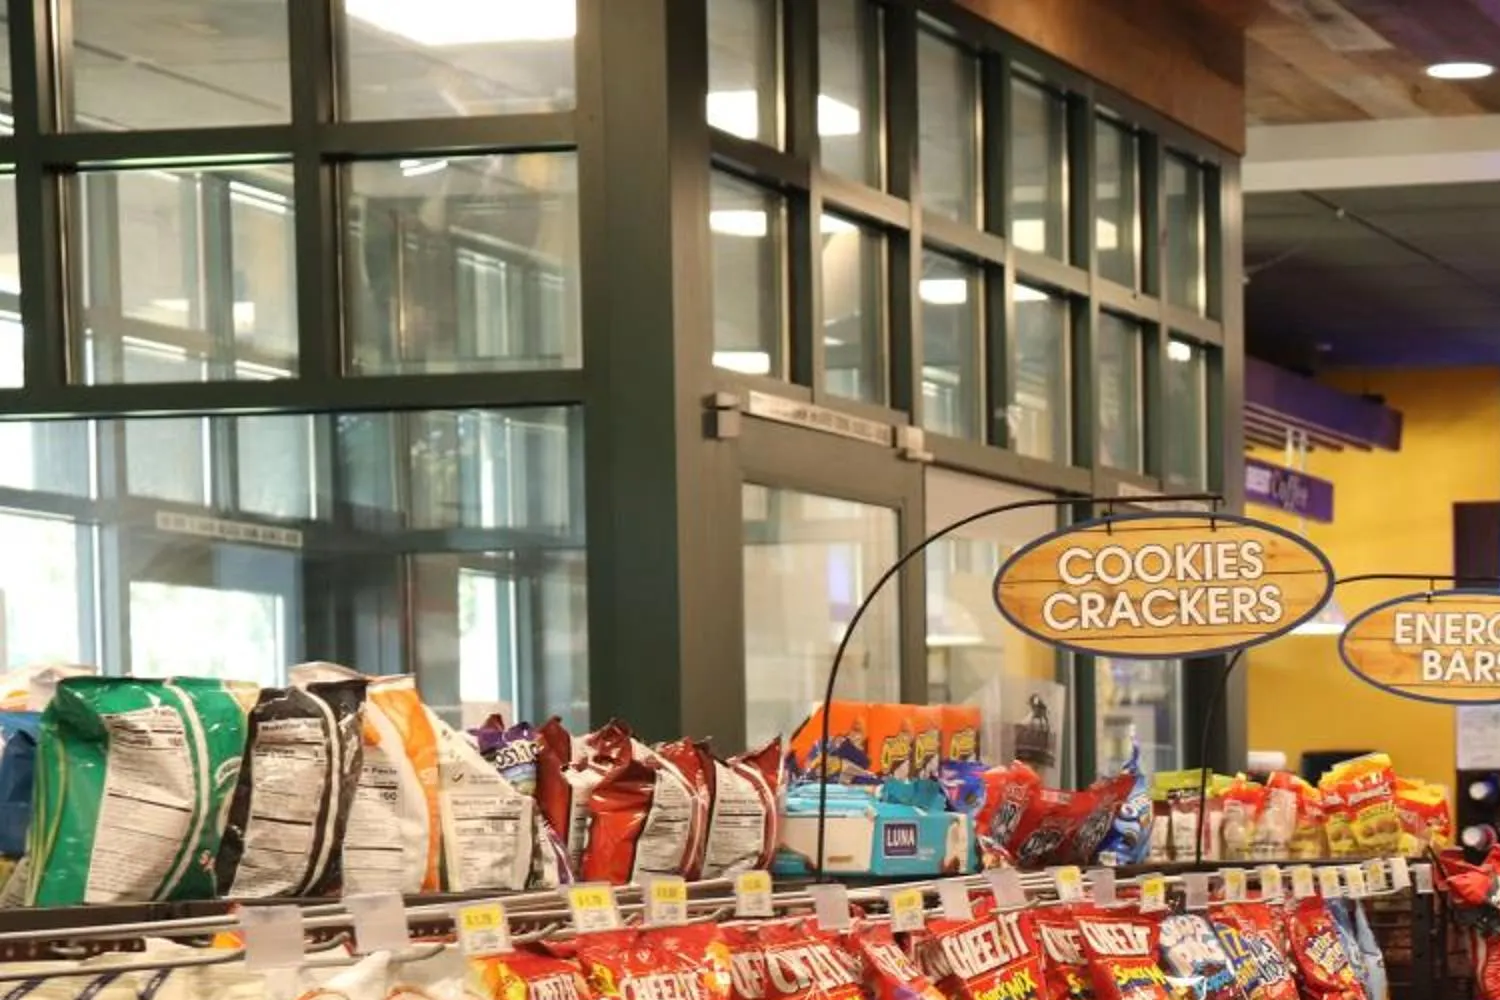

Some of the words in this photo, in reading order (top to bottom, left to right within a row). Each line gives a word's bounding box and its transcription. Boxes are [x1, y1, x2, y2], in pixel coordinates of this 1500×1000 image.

[1057, 541, 1265, 586] COOKIES
[1042, 584, 1284, 632] CRACKERS
[886, 823, 915, 848] LUNA
